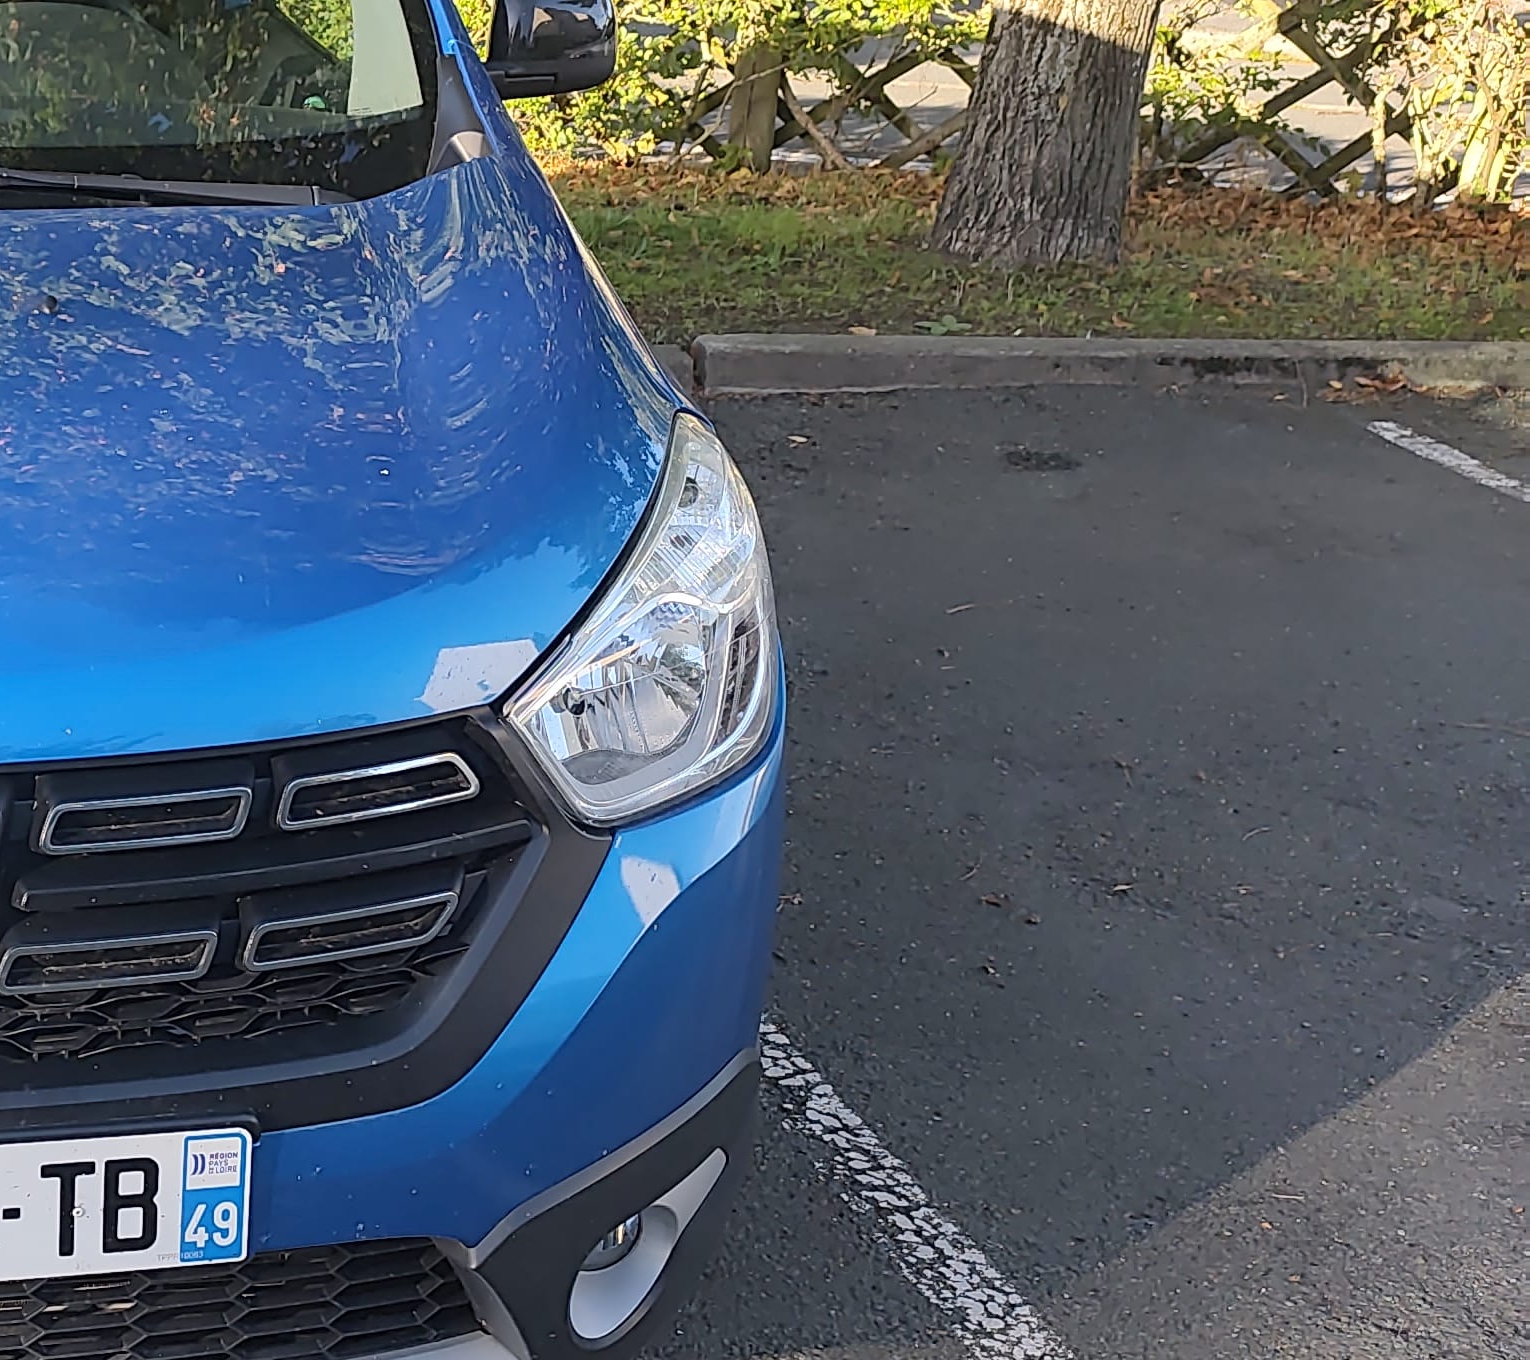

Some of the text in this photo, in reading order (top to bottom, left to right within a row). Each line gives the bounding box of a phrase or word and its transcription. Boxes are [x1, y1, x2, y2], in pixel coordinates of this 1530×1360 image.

[208, 1158, 229, 1166] PAYS
[215, 1165, 238, 1174] LOIRE
[184, 1201, 239, 1249] 49
